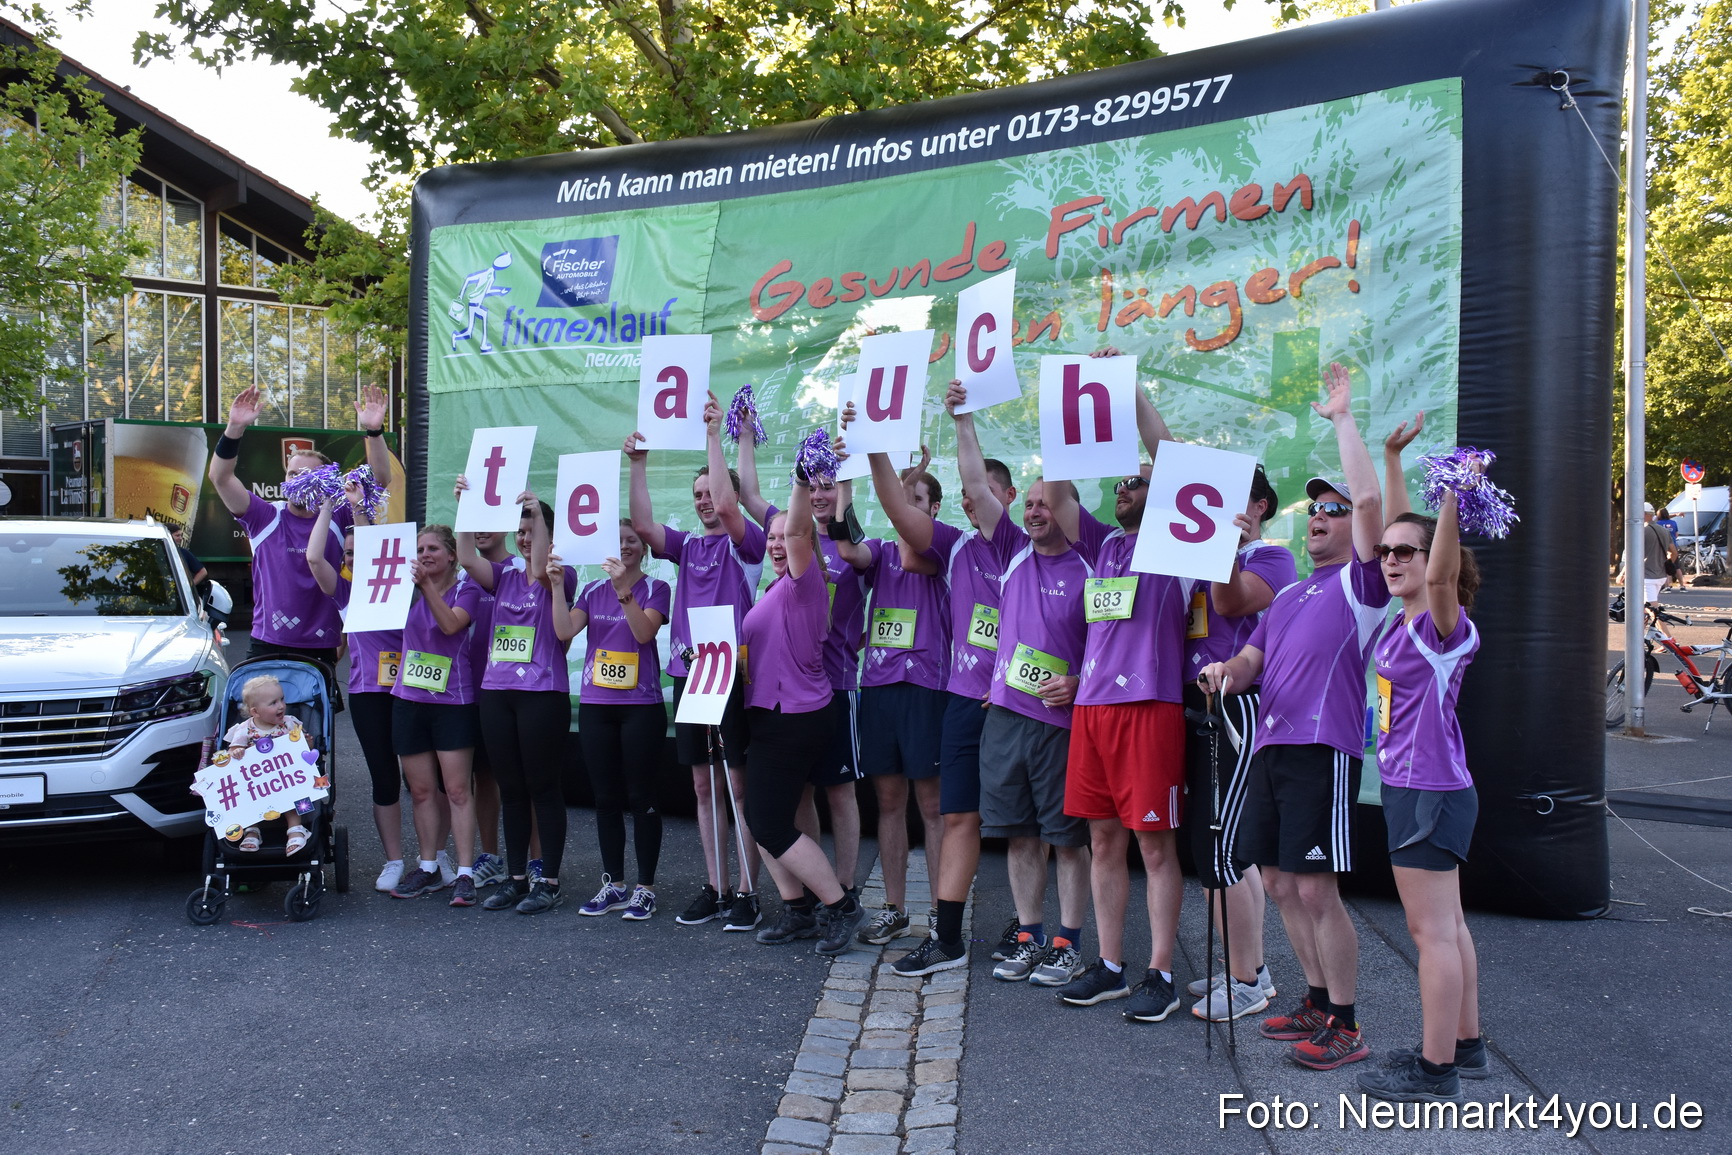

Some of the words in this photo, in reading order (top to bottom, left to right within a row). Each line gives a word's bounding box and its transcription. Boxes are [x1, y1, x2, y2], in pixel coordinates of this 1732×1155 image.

[556, 179, 611, 203] Mich
[617, 172, 673, 197] kann
[680, 166, 732, 190] man
[740, 144, 840, 183] mieten!
[846, 138, 912, 168] Infos
[921, 124, 1000, 157] unter
[1007, 74, 1233, 142] 0173-8299577
[552, 258, 605, 273] Fischer
[750, 220, 1011, 322] Gesunde
[1046, 173, 1313, 259] Firmen
[556, 271, 598, 279] AUTOMOBILE
[1097, 218, 1360, 352] länger!
[502, 297, 678, 347] firmenlauf
[967, 312, 996, 373] c
[654, 365, 688, 419] a
[866, 365, 908, 422] u
[1063, 364, 1113, 445] h
[484, 446, 506, 506] t
[568, 484, 599, 536] e
[1169, 483, 1223, 543] s
[367, 538, 405, 604] #
[1048, 589, 1067, 597] LILA.
[1093, 592, 1122, 609] 683
[495, 638, 527, 652] 2096
[878, 622, 903, 637] 679
[407, 663, 442, 681] 2098
[601, 663, 626, 678] 688
[688, 641, 732, 695] m
[240, 752, 294, 781] team
[247, 769, 307, 801] fuchs
[209, 813, 222, 826] TOP
